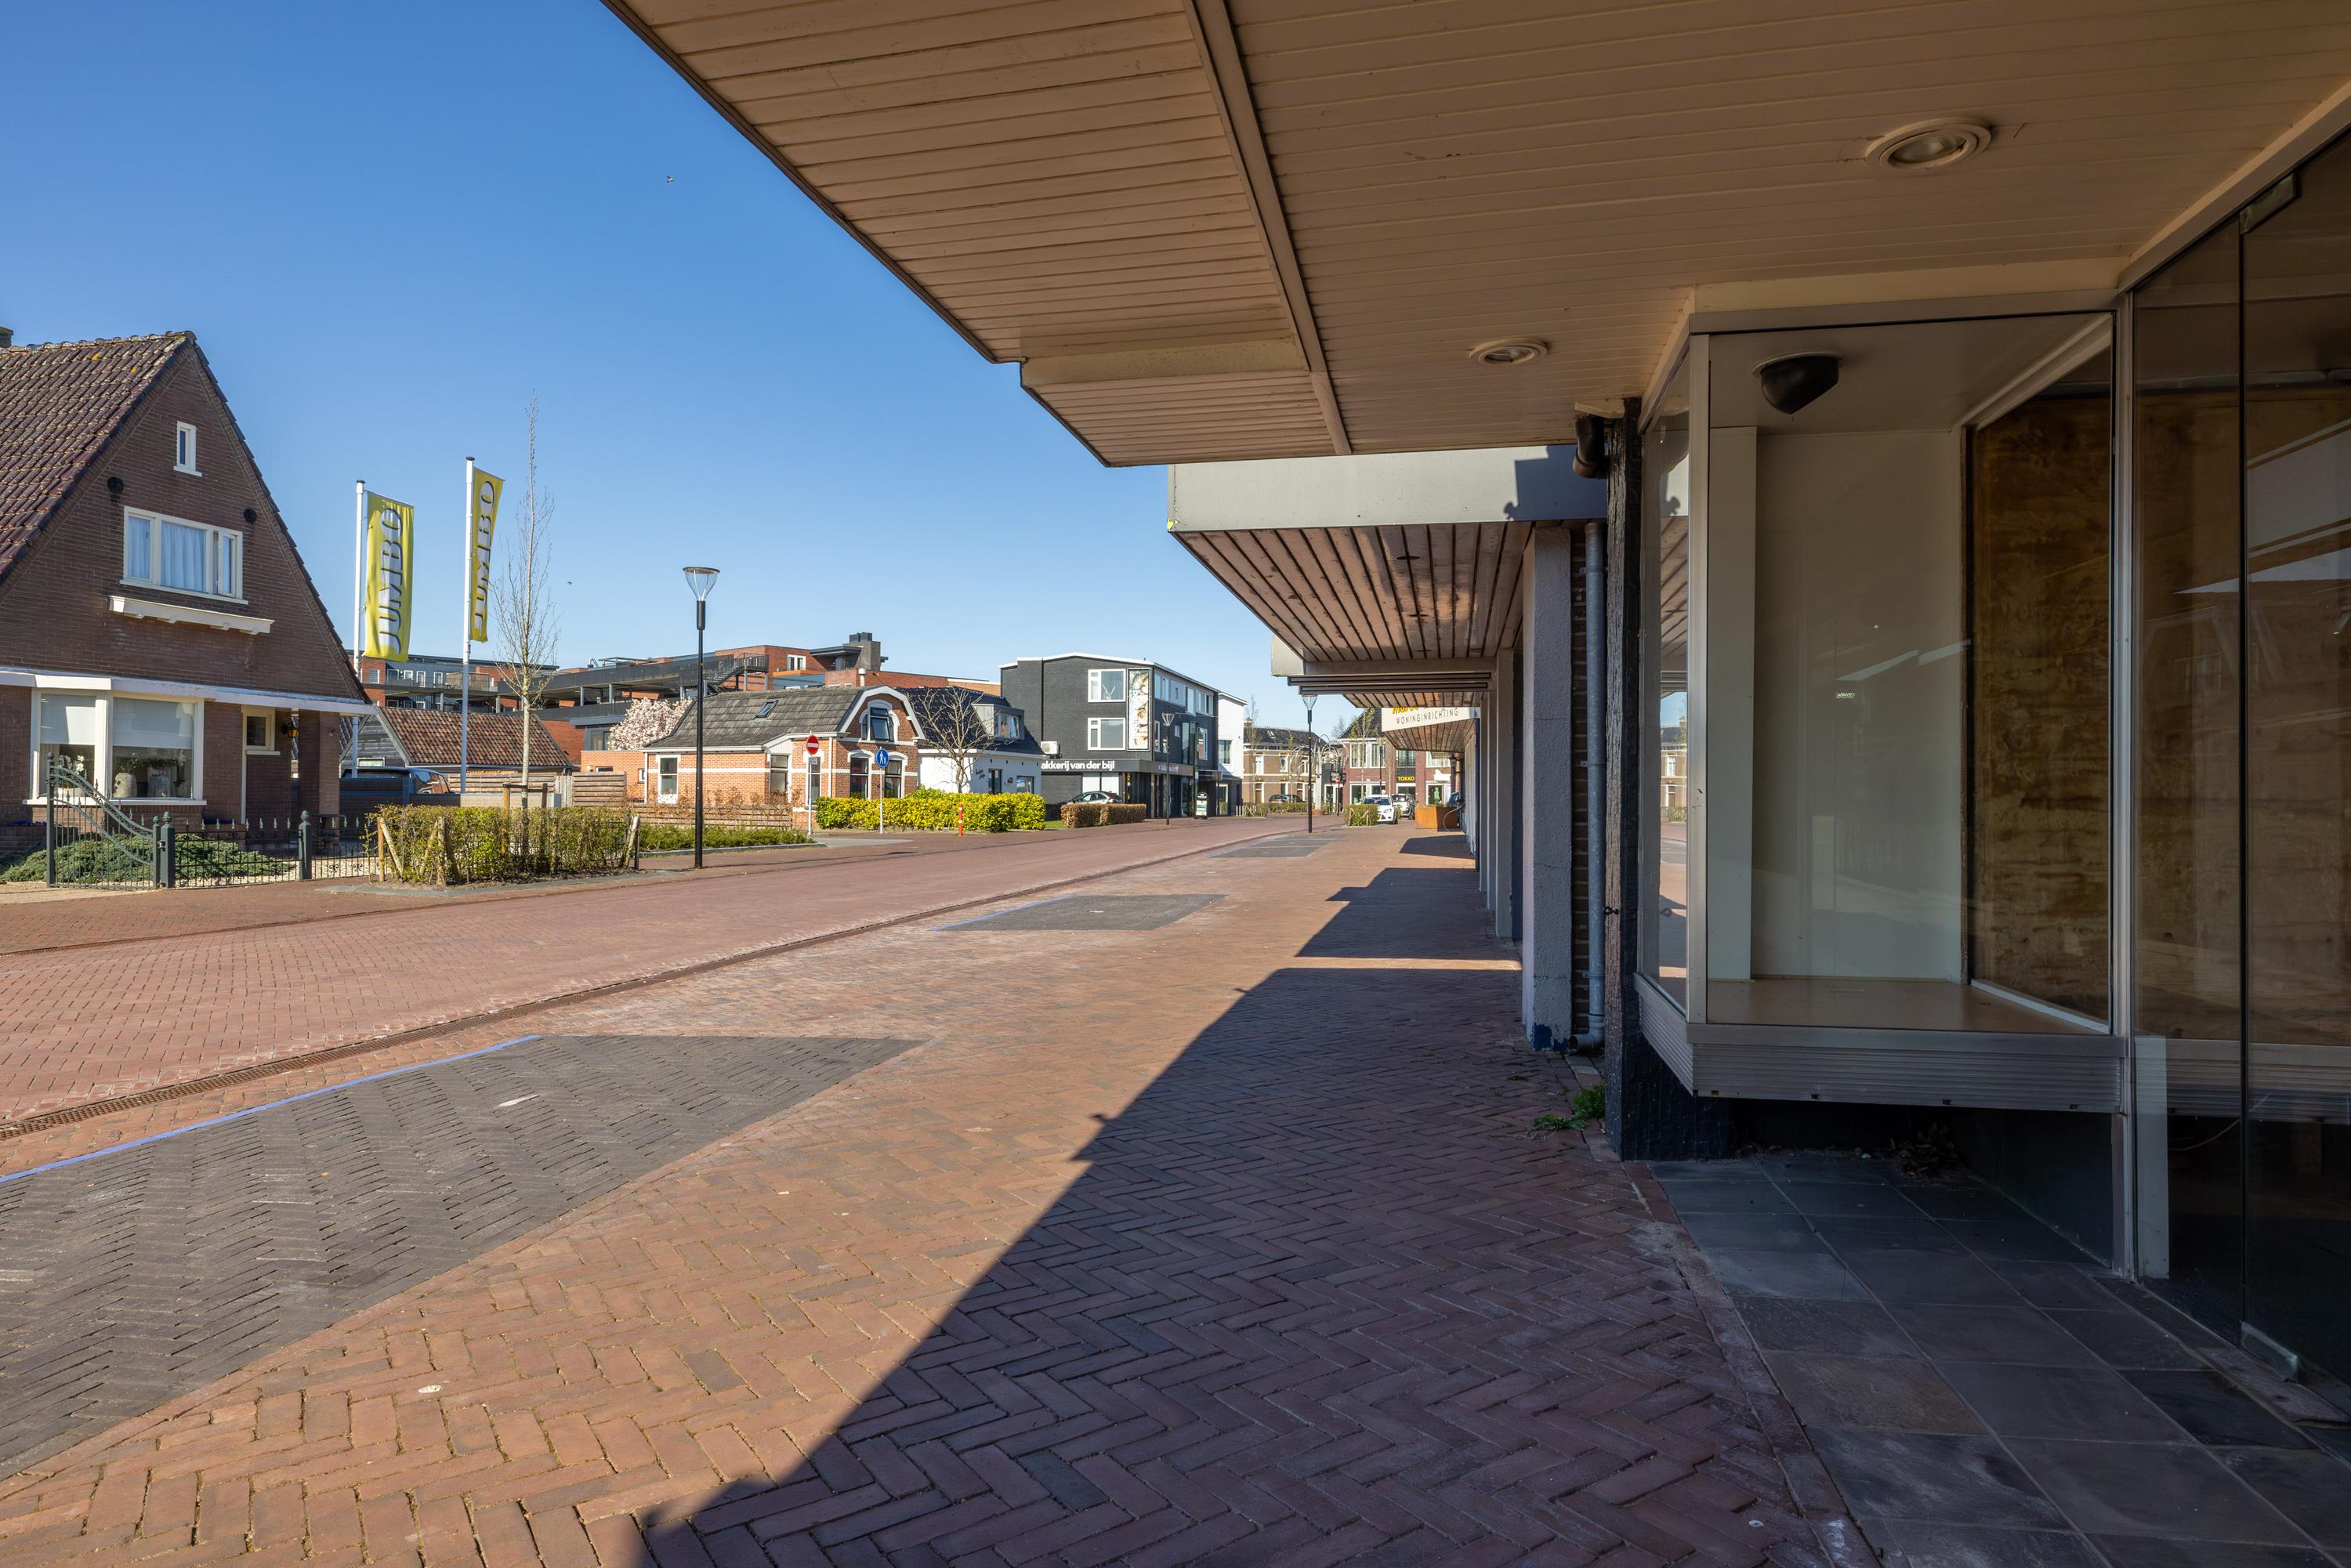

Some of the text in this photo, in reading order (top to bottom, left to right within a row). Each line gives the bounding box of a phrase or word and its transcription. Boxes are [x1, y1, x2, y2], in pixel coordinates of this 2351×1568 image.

[379, 508, 403, 654] JUMBO
[474, 480, 494, 631] JUMBO
[1041, 760, 1070, 771] akkerij
[1086, 760, 1101, 770] der
[1102, 760, 1115, 771] bijl
